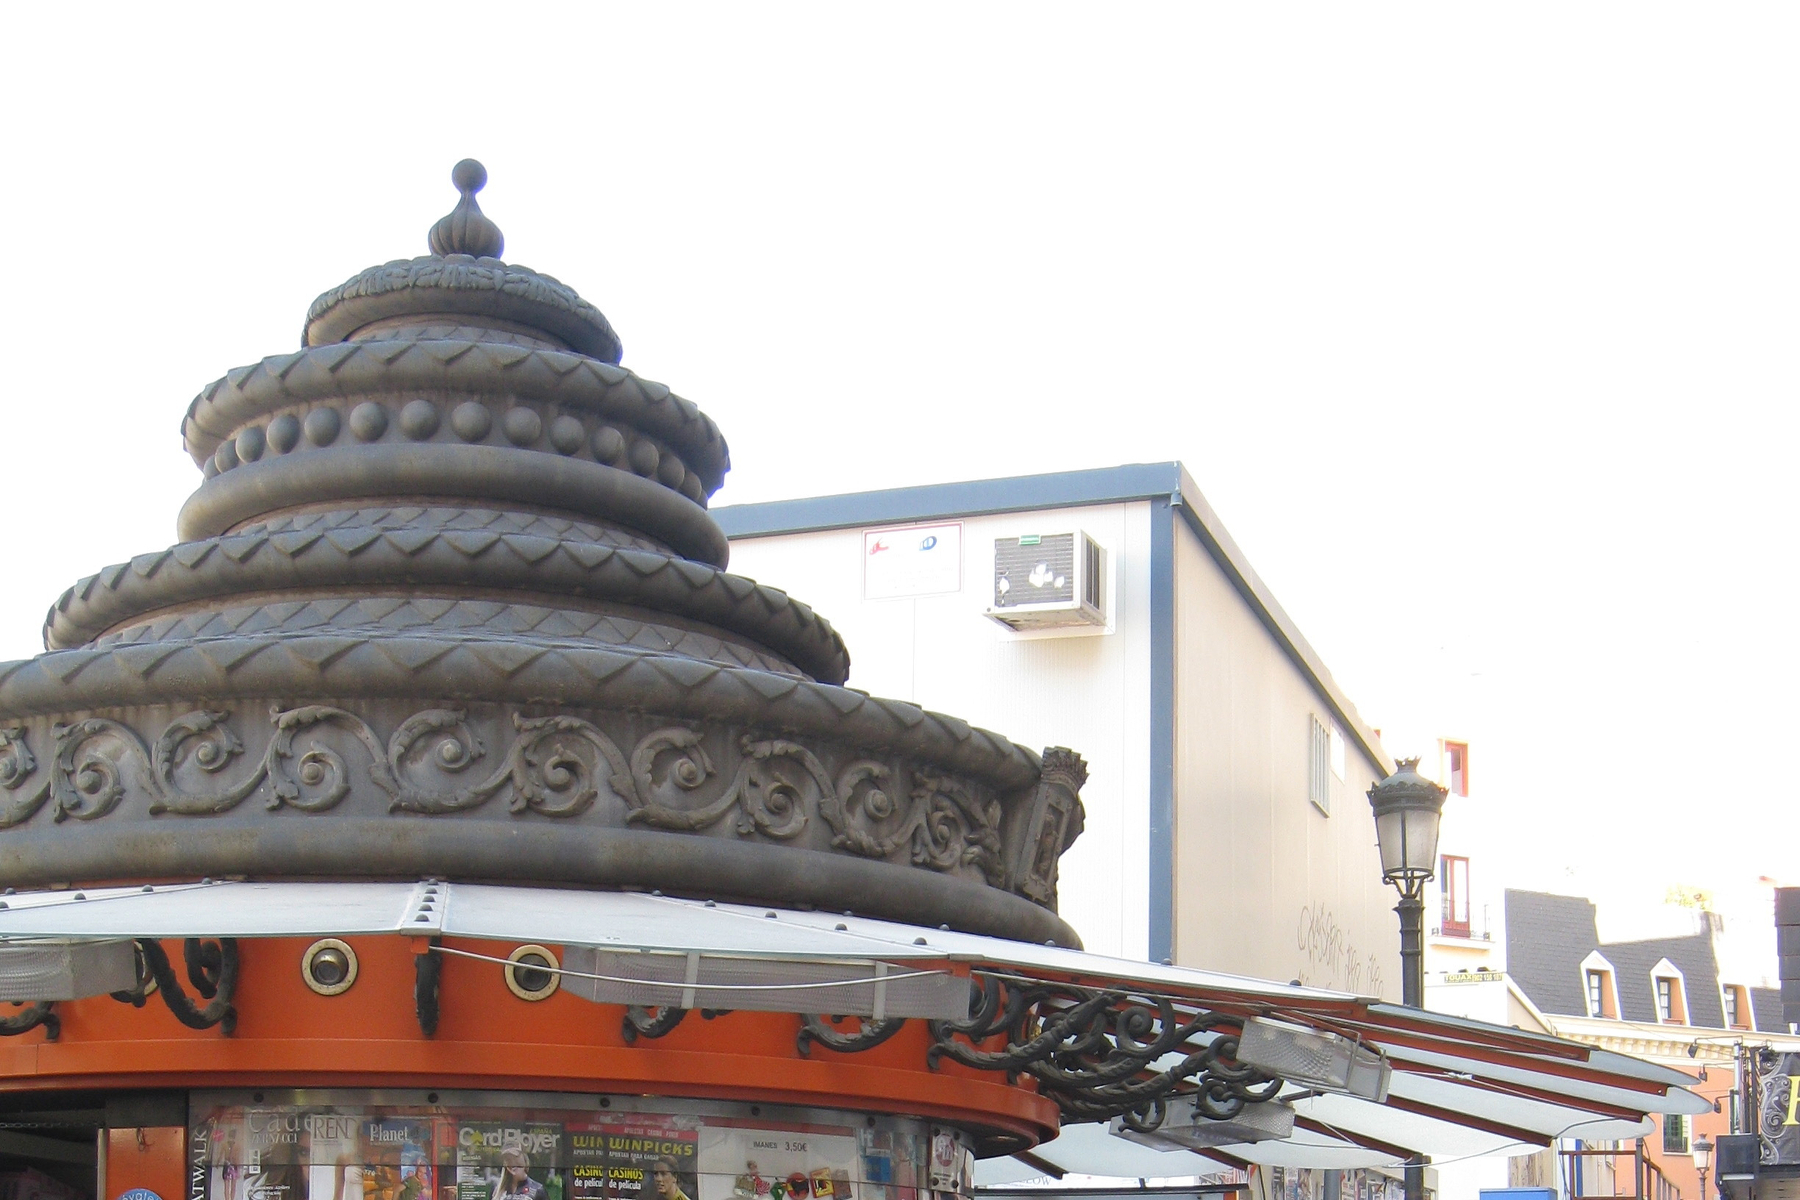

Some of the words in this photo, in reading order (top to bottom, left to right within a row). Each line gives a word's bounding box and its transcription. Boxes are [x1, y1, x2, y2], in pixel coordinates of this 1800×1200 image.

[370, 1124, 409, 1142] Planet
[609, 1137, 693, 1156] WINPICKS
[754, 1141, 778, 1149] IMANES
[785, 1142, 807, 1152] 3,50€
[609, 1167, 644, 1179] CASINOS
[609, 1180, 617, 1188] de
[618, 1181, 641, 1190] película
